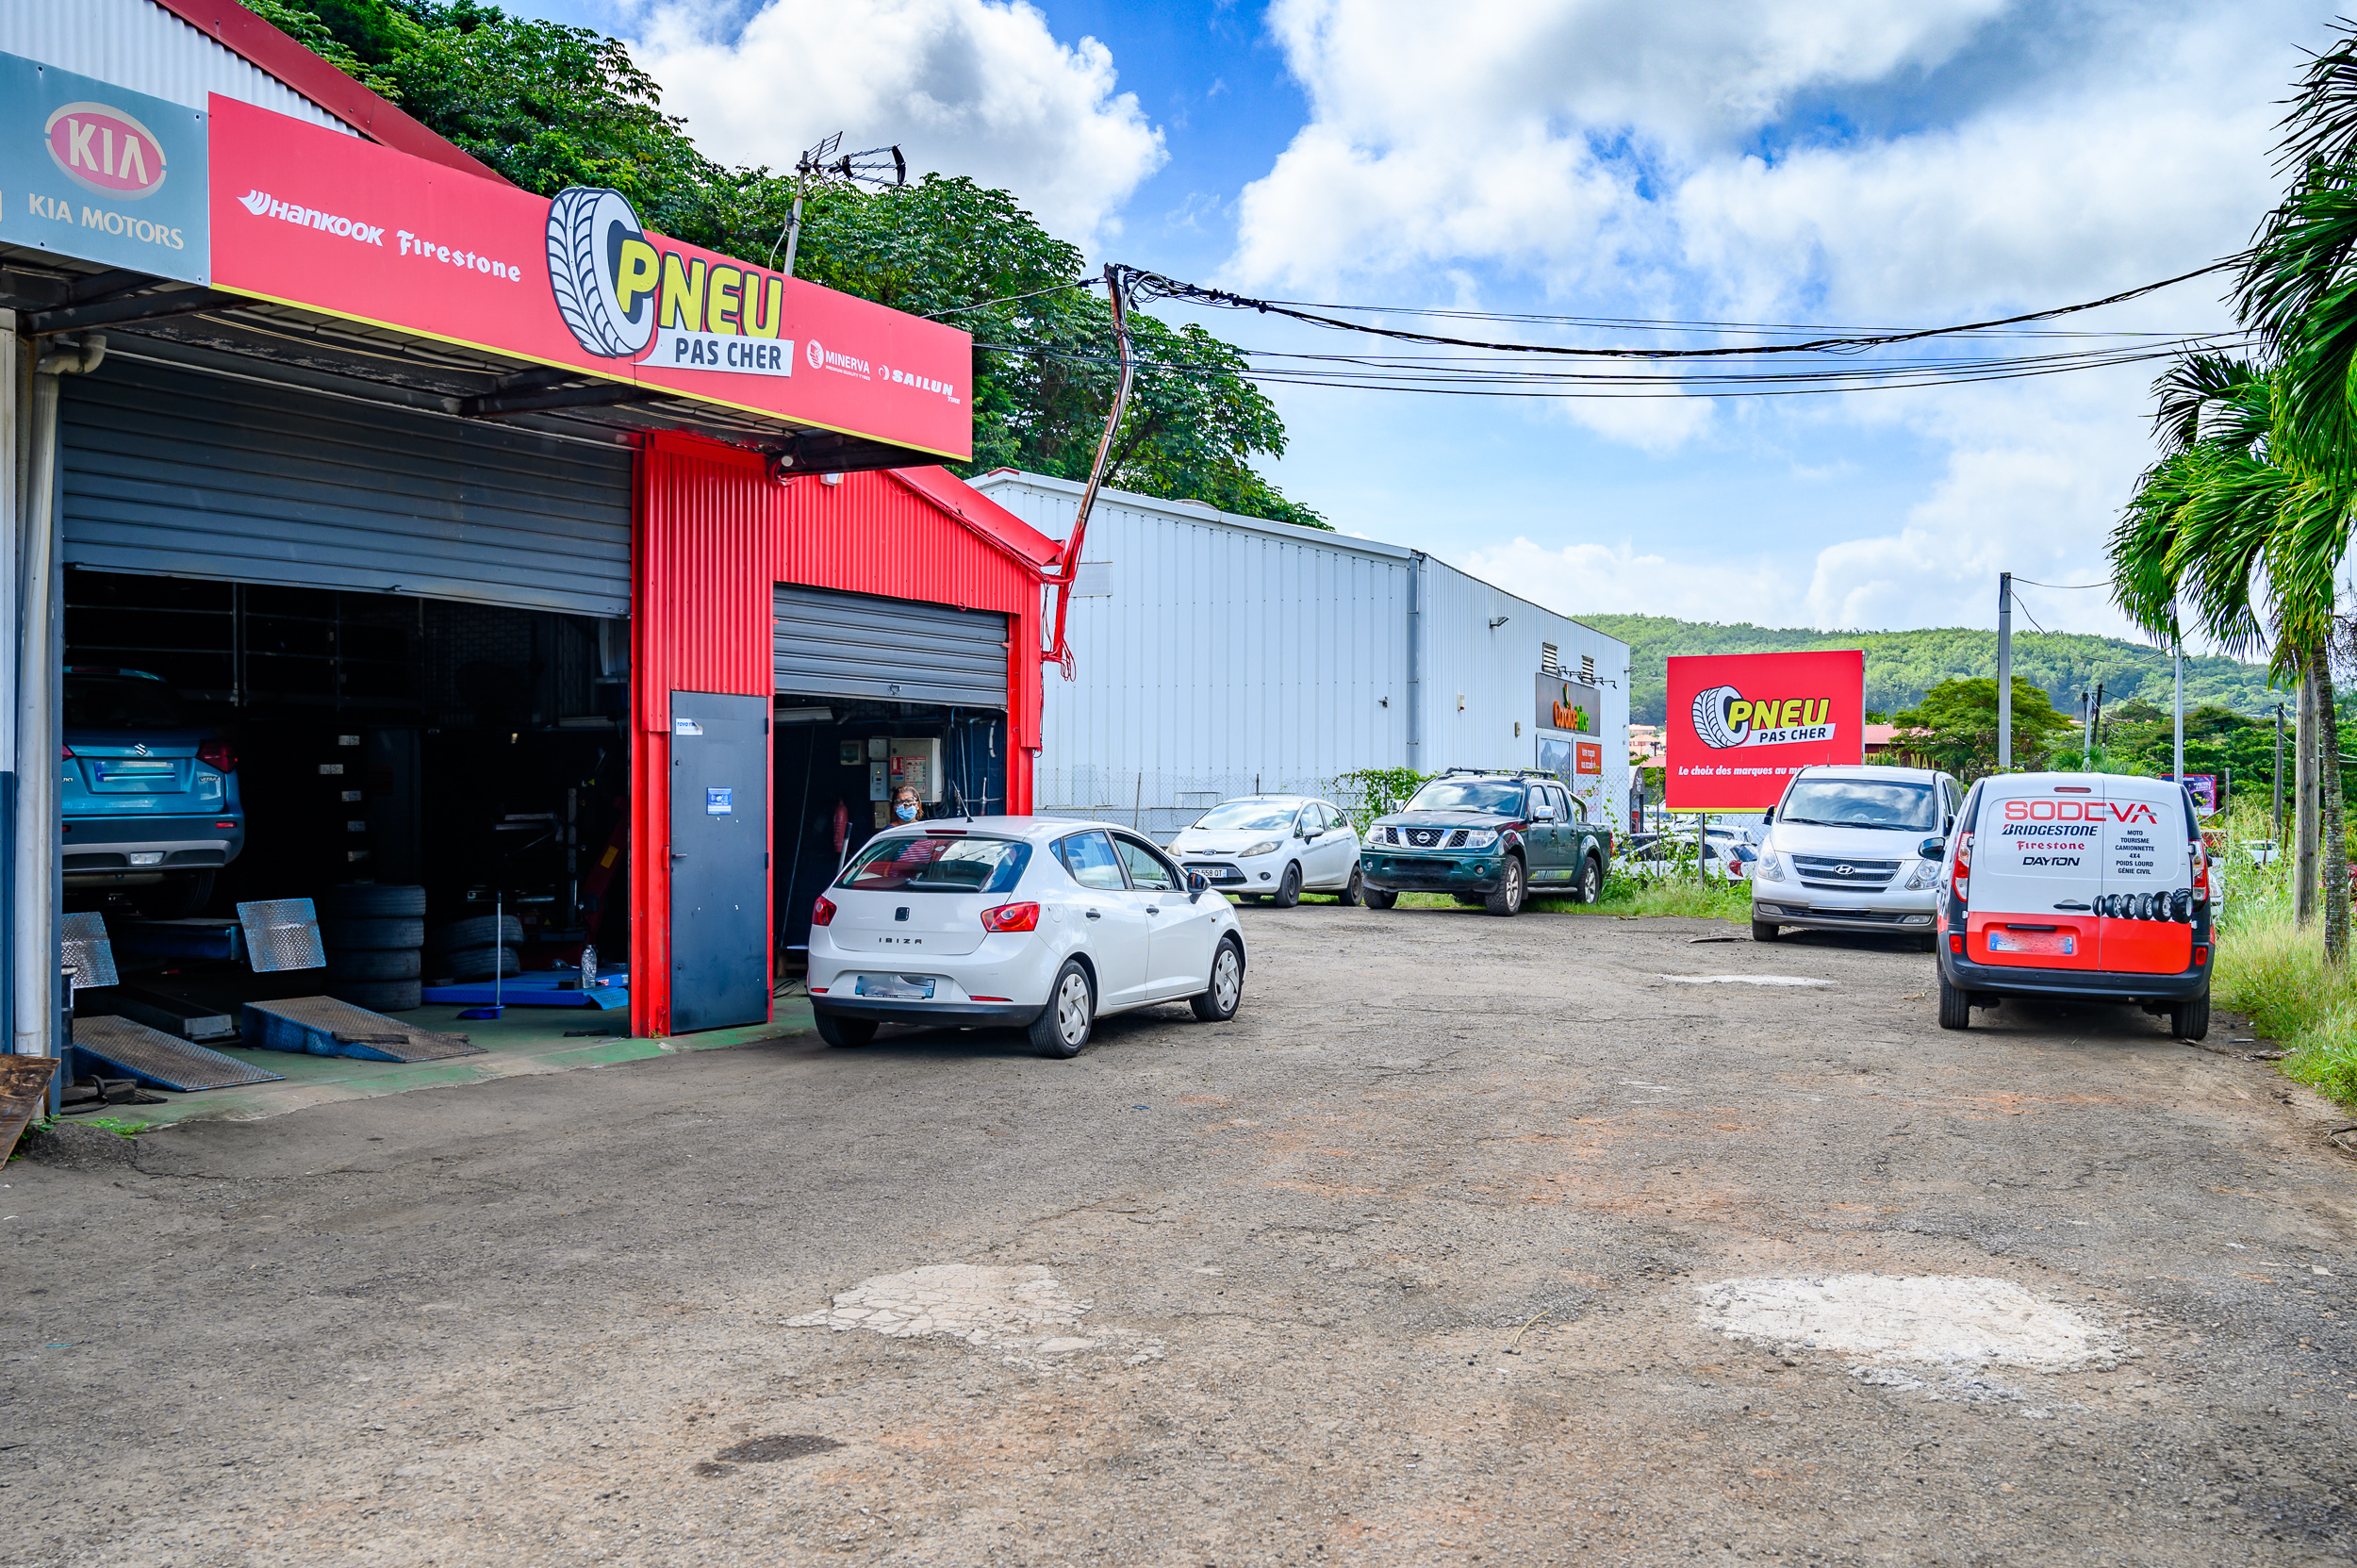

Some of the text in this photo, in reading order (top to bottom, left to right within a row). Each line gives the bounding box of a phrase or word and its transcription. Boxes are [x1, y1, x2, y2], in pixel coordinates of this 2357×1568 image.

[68, 118, 148, 185] KIA
[29, 192, 184, 250] KIA MOTORS
[396, 230, 521, 282] Firestone
[615, 238, 784, 339] PNEU
[675, 338, 782, 371] PAS CHER
[826, 350, 870, 374] MINERVA
[892, 370, 953, 396] SAILUN
[1727, 698, 1831, 731] PNEU
[1759, 726, 1827, 743] PAS CHER
[1678, 766, 1689, 776] Le
[1690, 766, 1714, 776] choix
[1716, 765, 1732, 776] des
[1734, 767, 1772, 777] marques
[1774, 767, 1787, 775] au
[2004, 801, 2157, 825] SODEVA
[2002, 823, 2098, 836] BRIDGESTONE
[2016, 840, 2085, 851] Firestone
[2022, 856, 2080, 866] DAYTON
